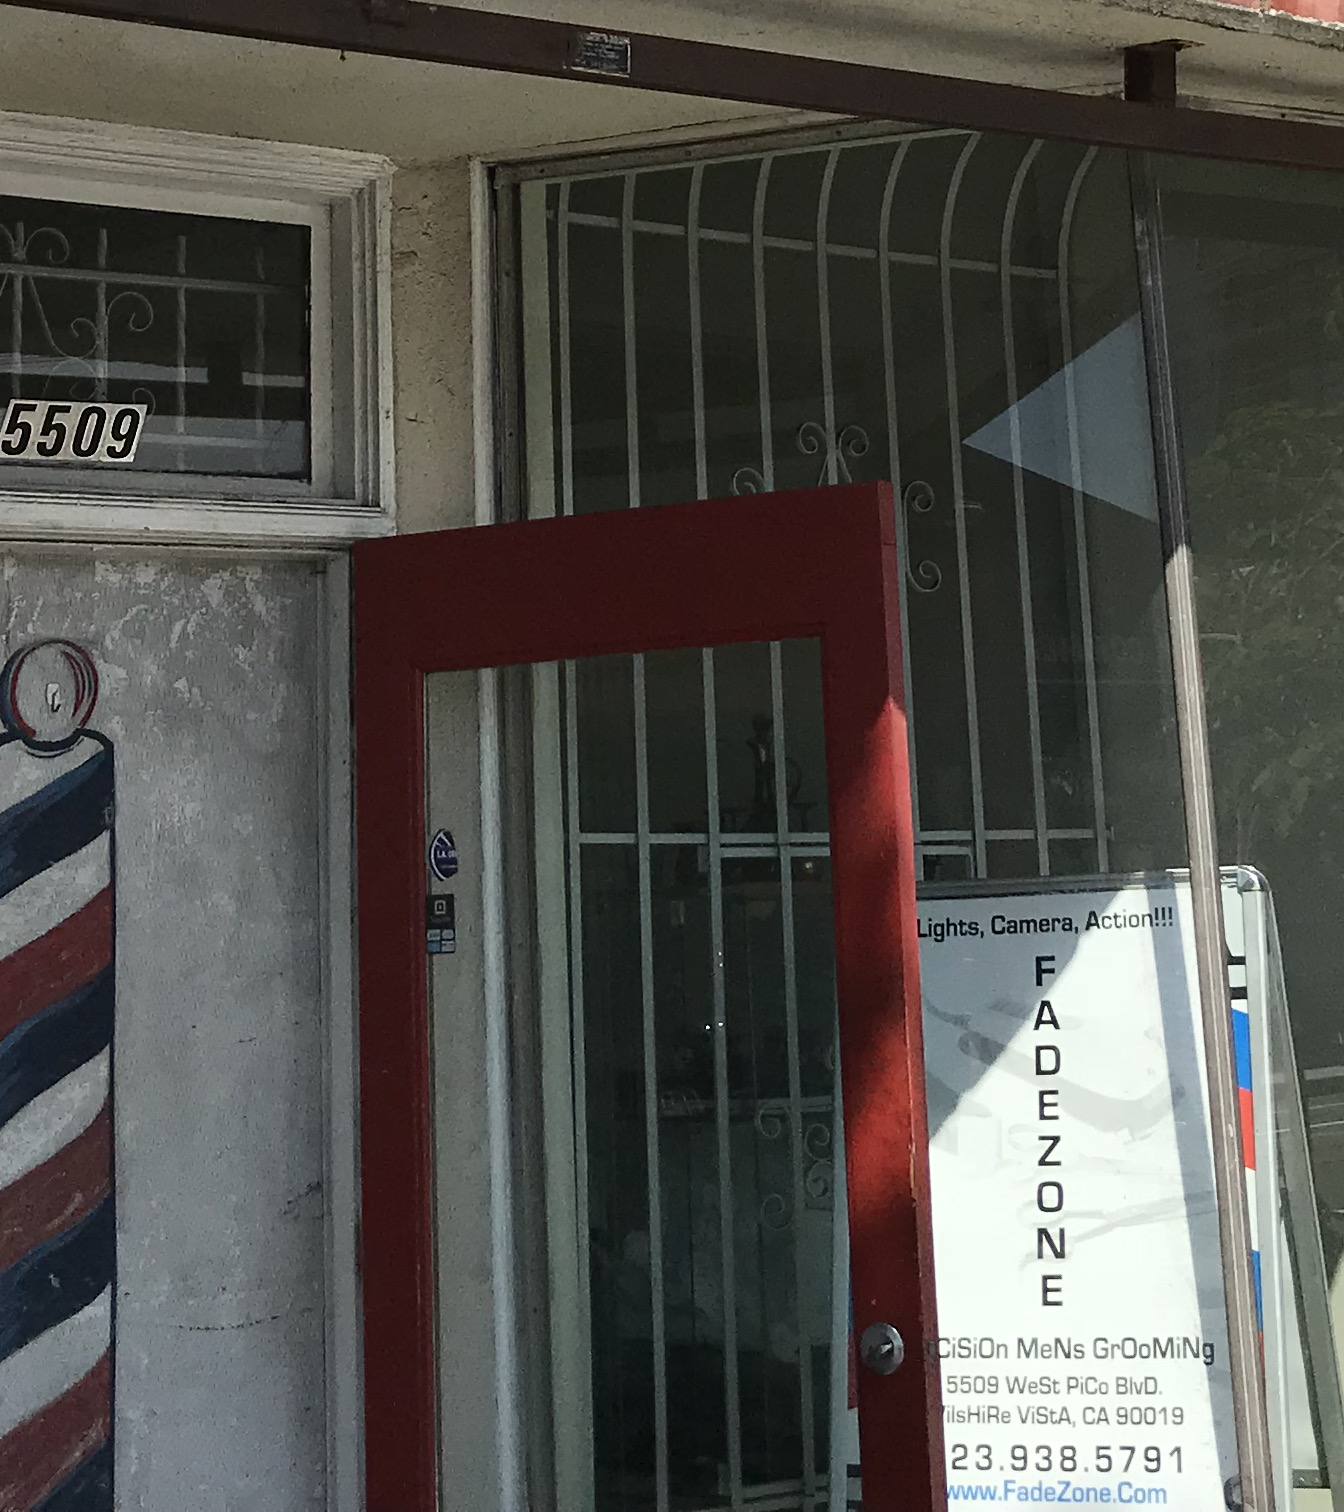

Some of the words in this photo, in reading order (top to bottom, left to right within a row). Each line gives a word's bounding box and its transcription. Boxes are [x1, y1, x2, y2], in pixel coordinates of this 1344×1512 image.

[0, 403, 140, 459] 5509
[917, 916, 985, 943] Lights,
[990, 914, 1079, 935] Camera,
[1085, 906, 1174, 932] Action!!!
[1016, 1337, 1085, 1359] MeNs
[946, 1375, 999, 1394] 5509
[1006, 1376, 1060, 1395] WeSt
[1066, 1377, 1109, 1395] PiCo
[1115, 1376, 1163, 1395] BlvD.
[942, 1404, 1012, 1425] ilsHiRe
[1082, 1406, 1110, 1425] CA
[1115, 1406, 1185, 1425] 90019
